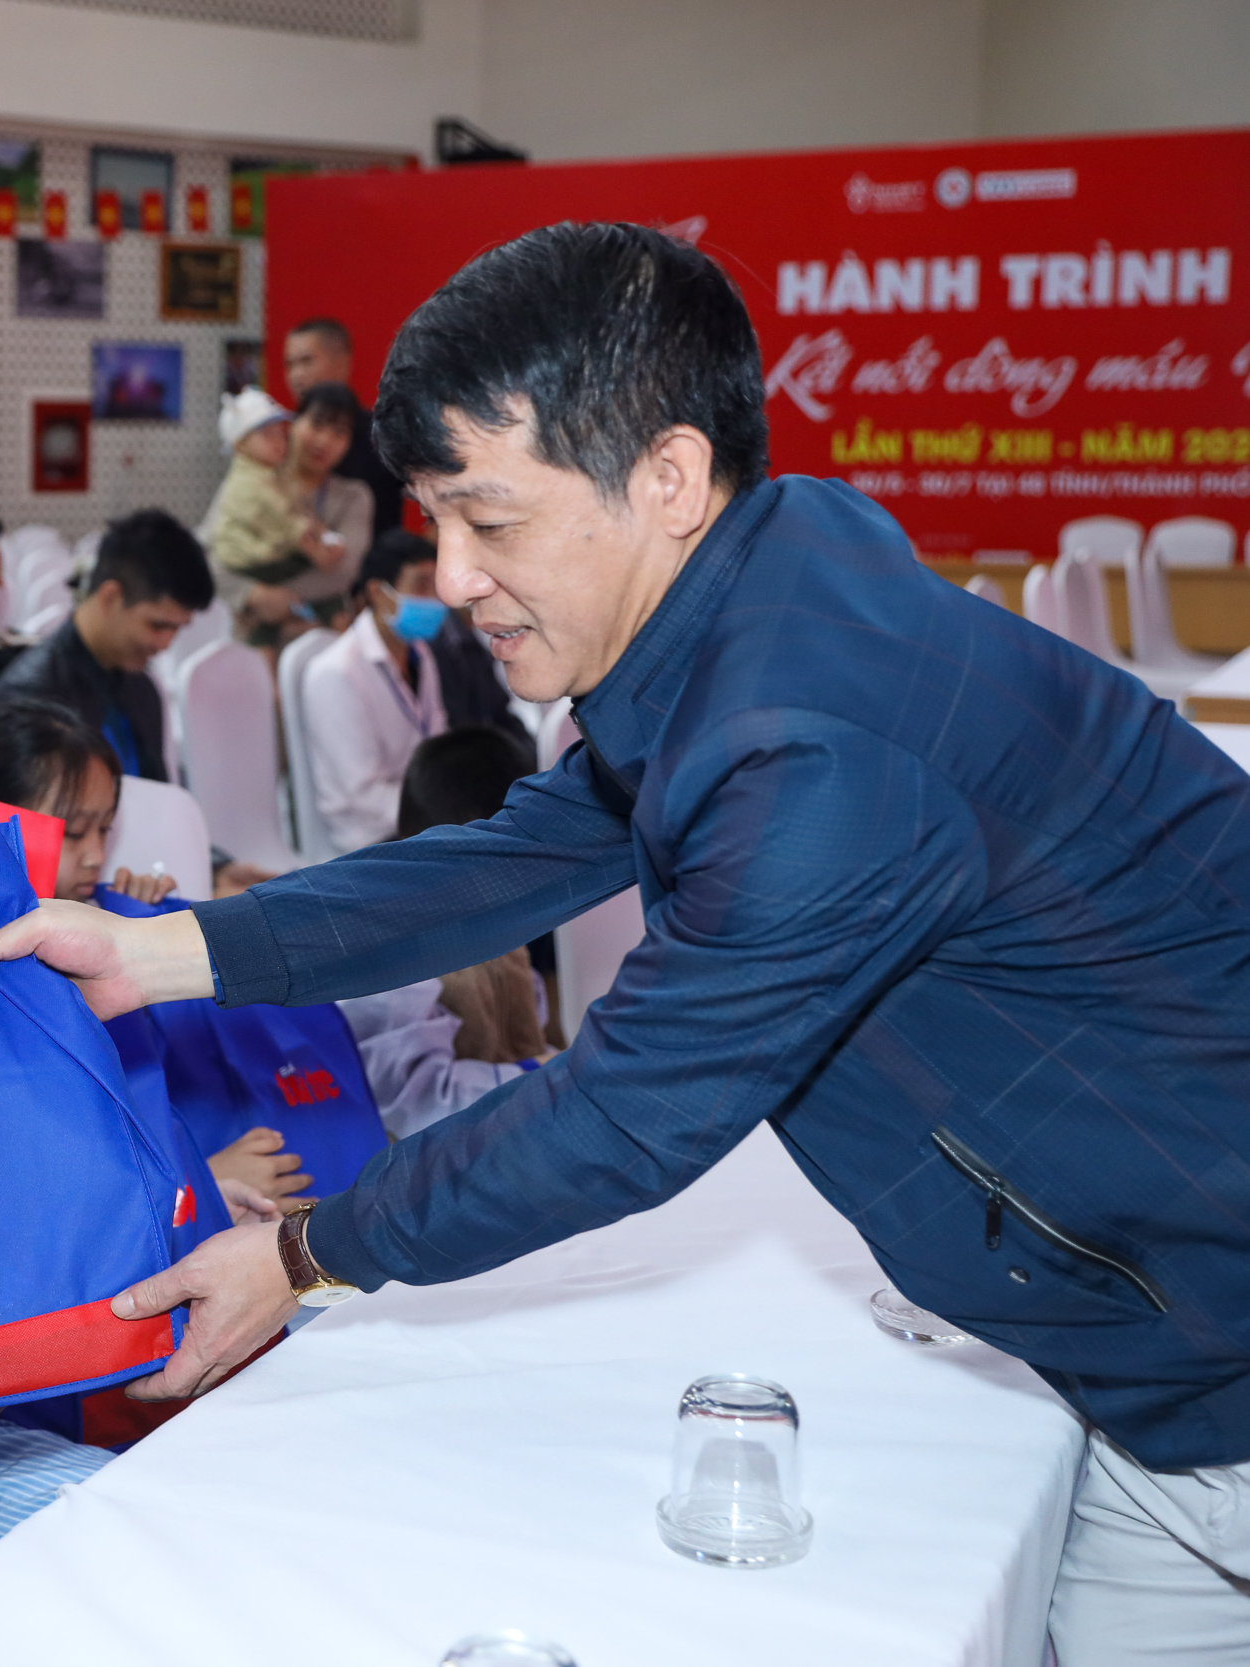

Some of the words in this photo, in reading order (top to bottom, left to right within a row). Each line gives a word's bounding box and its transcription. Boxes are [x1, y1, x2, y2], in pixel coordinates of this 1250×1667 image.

[776, 248, 981, 315] HÀNH
[1000, 238, 1231, 309] TRÌNH
[1085, 337, 1210, 392] máu
[909, 422, 983, 465] THỨ
[1081, 421, 1173, 465] NĂM
